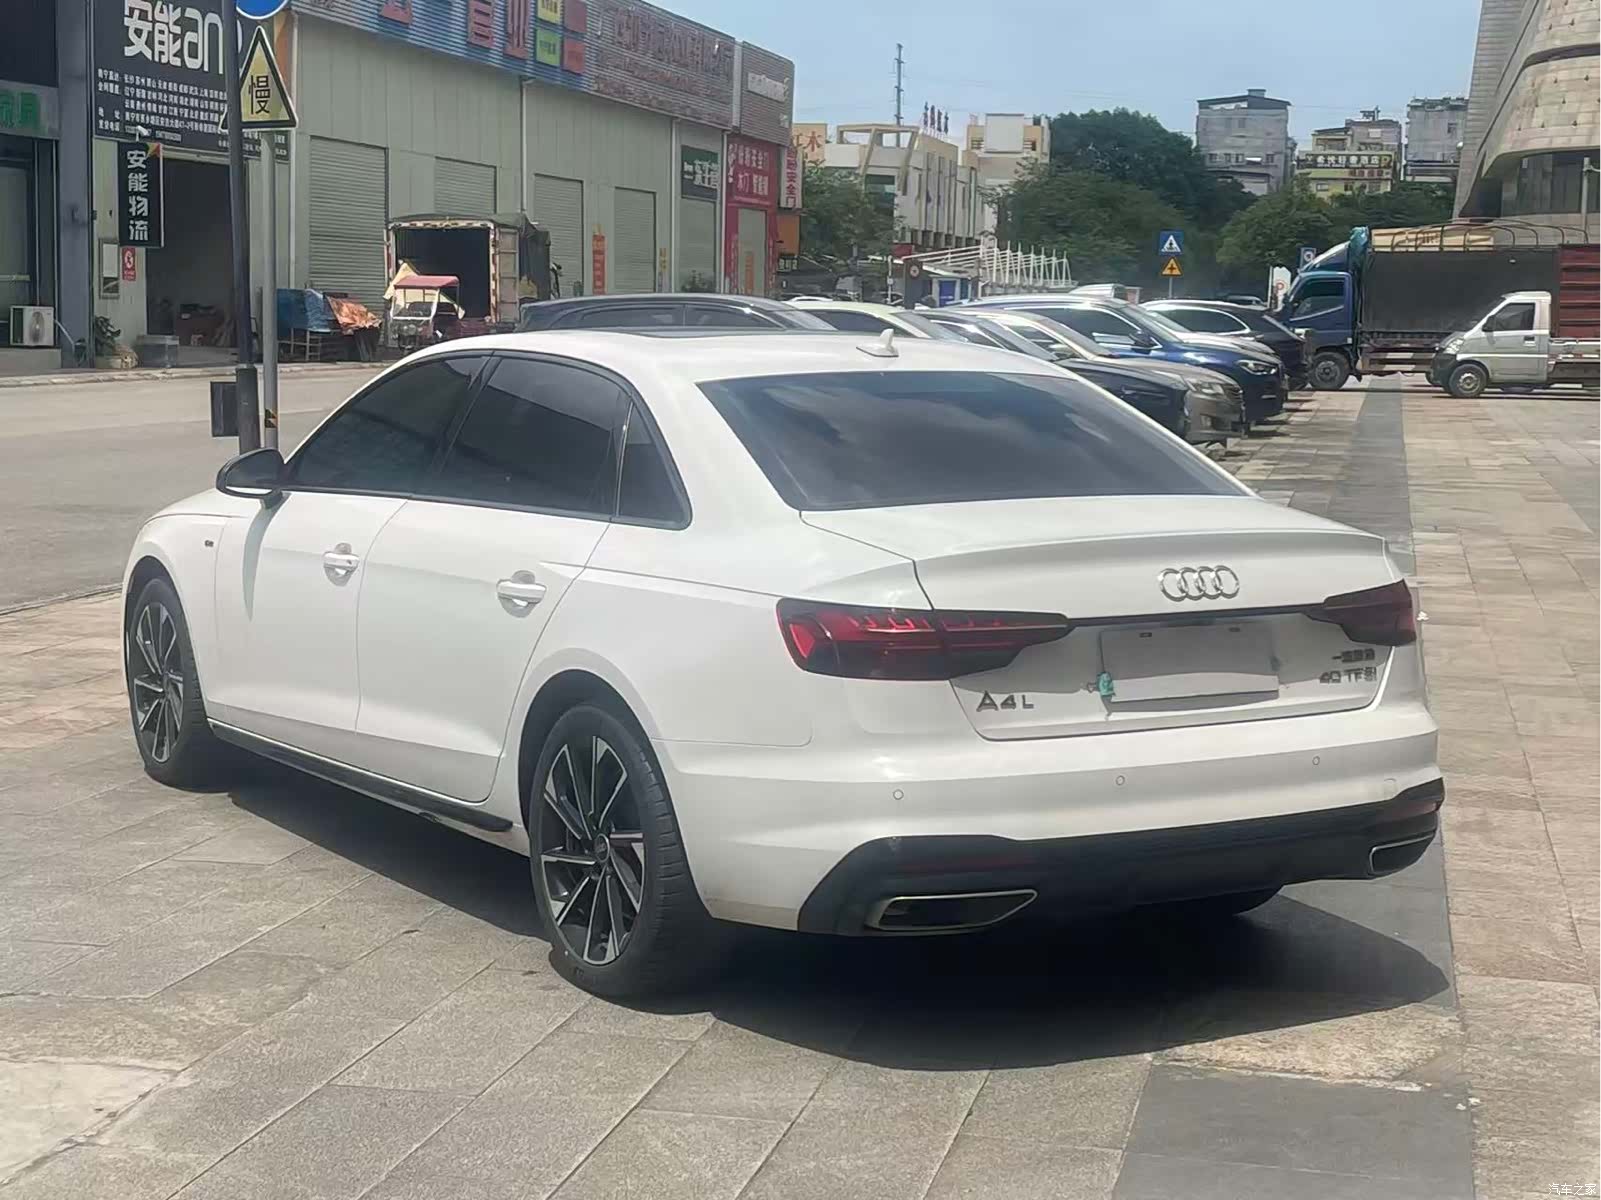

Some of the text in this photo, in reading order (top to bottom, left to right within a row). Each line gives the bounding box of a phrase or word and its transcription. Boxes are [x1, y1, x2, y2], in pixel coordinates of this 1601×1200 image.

[248, 75, 271, 115] 慢
[126, 149, 149, 241] 安能物流
